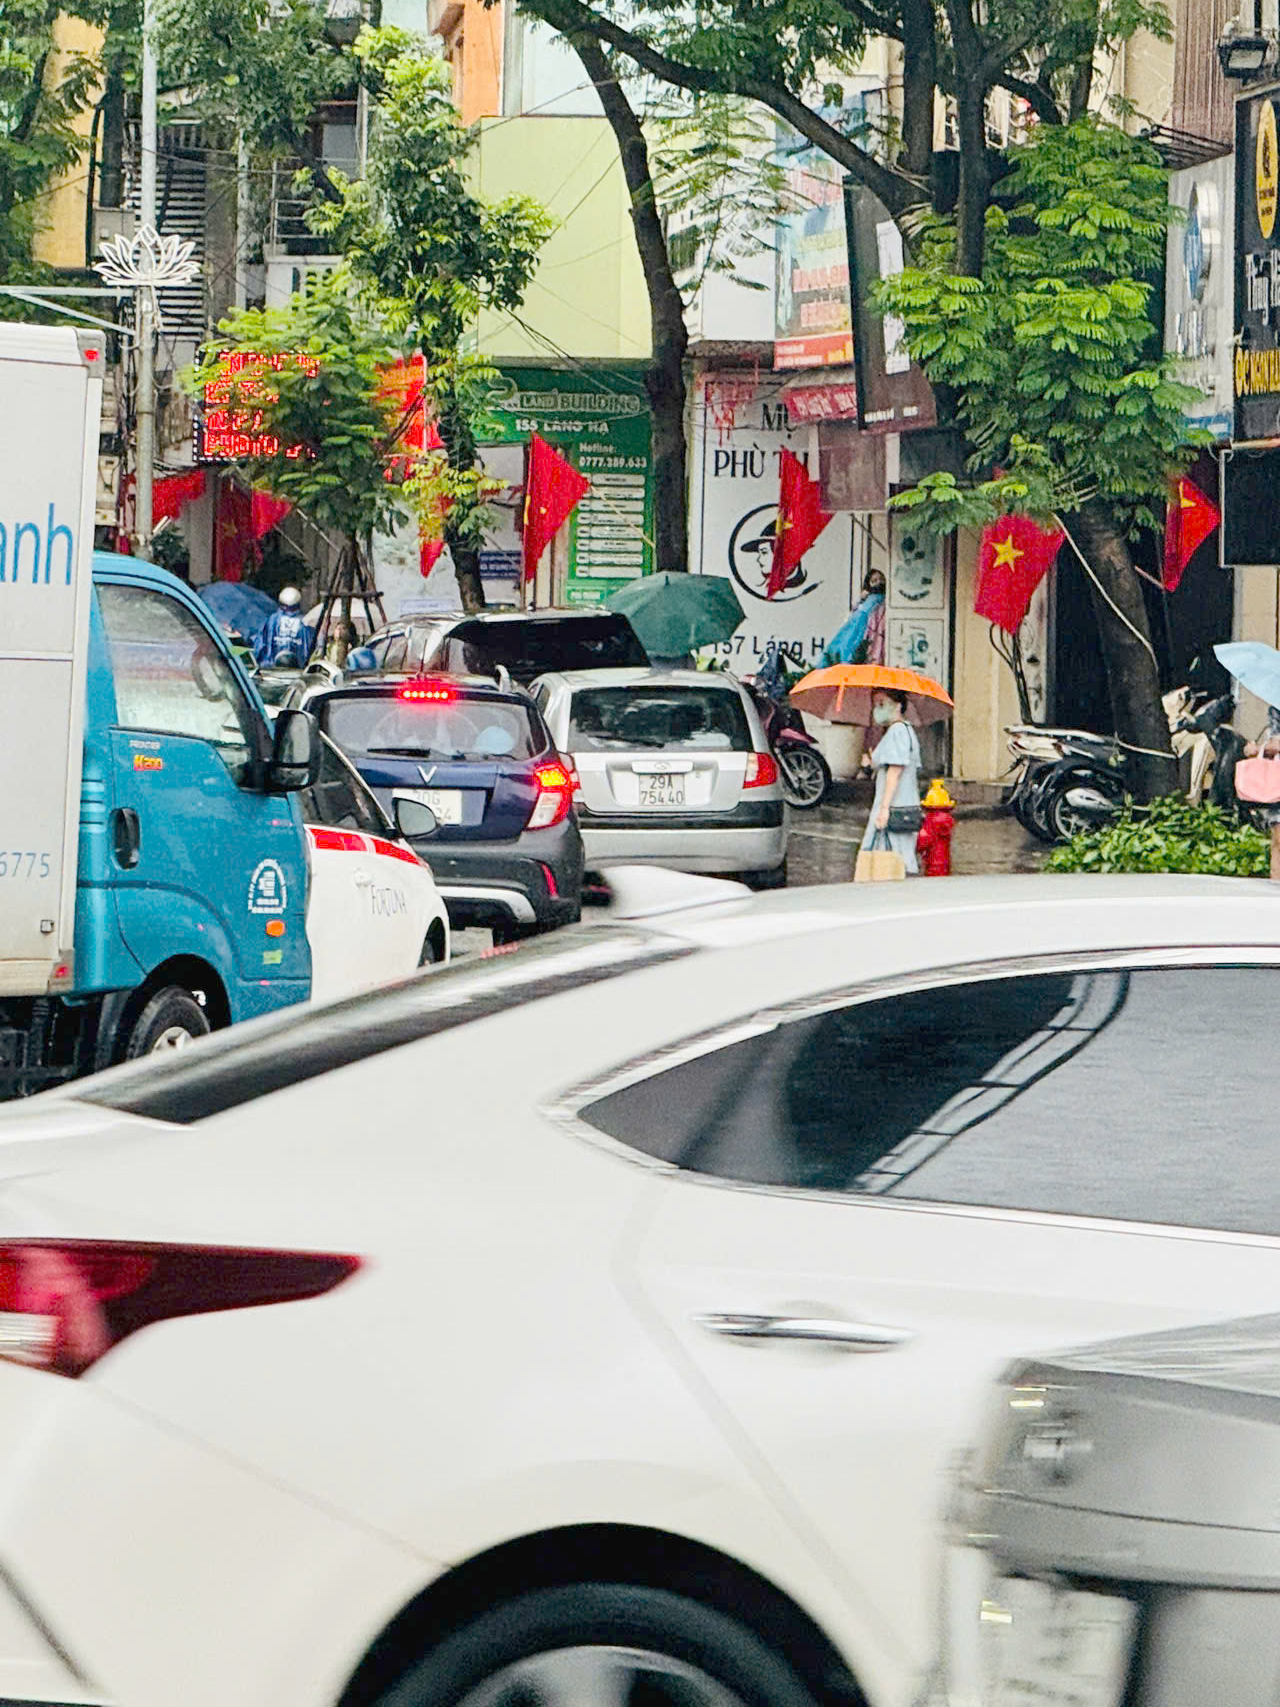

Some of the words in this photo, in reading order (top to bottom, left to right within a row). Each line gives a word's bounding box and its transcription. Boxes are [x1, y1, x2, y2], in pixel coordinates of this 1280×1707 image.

[559, 393, 640, 412] BUILDING
[713, 442, 766, 479] PHÙ
[649, 775, 673, 789] 29A
